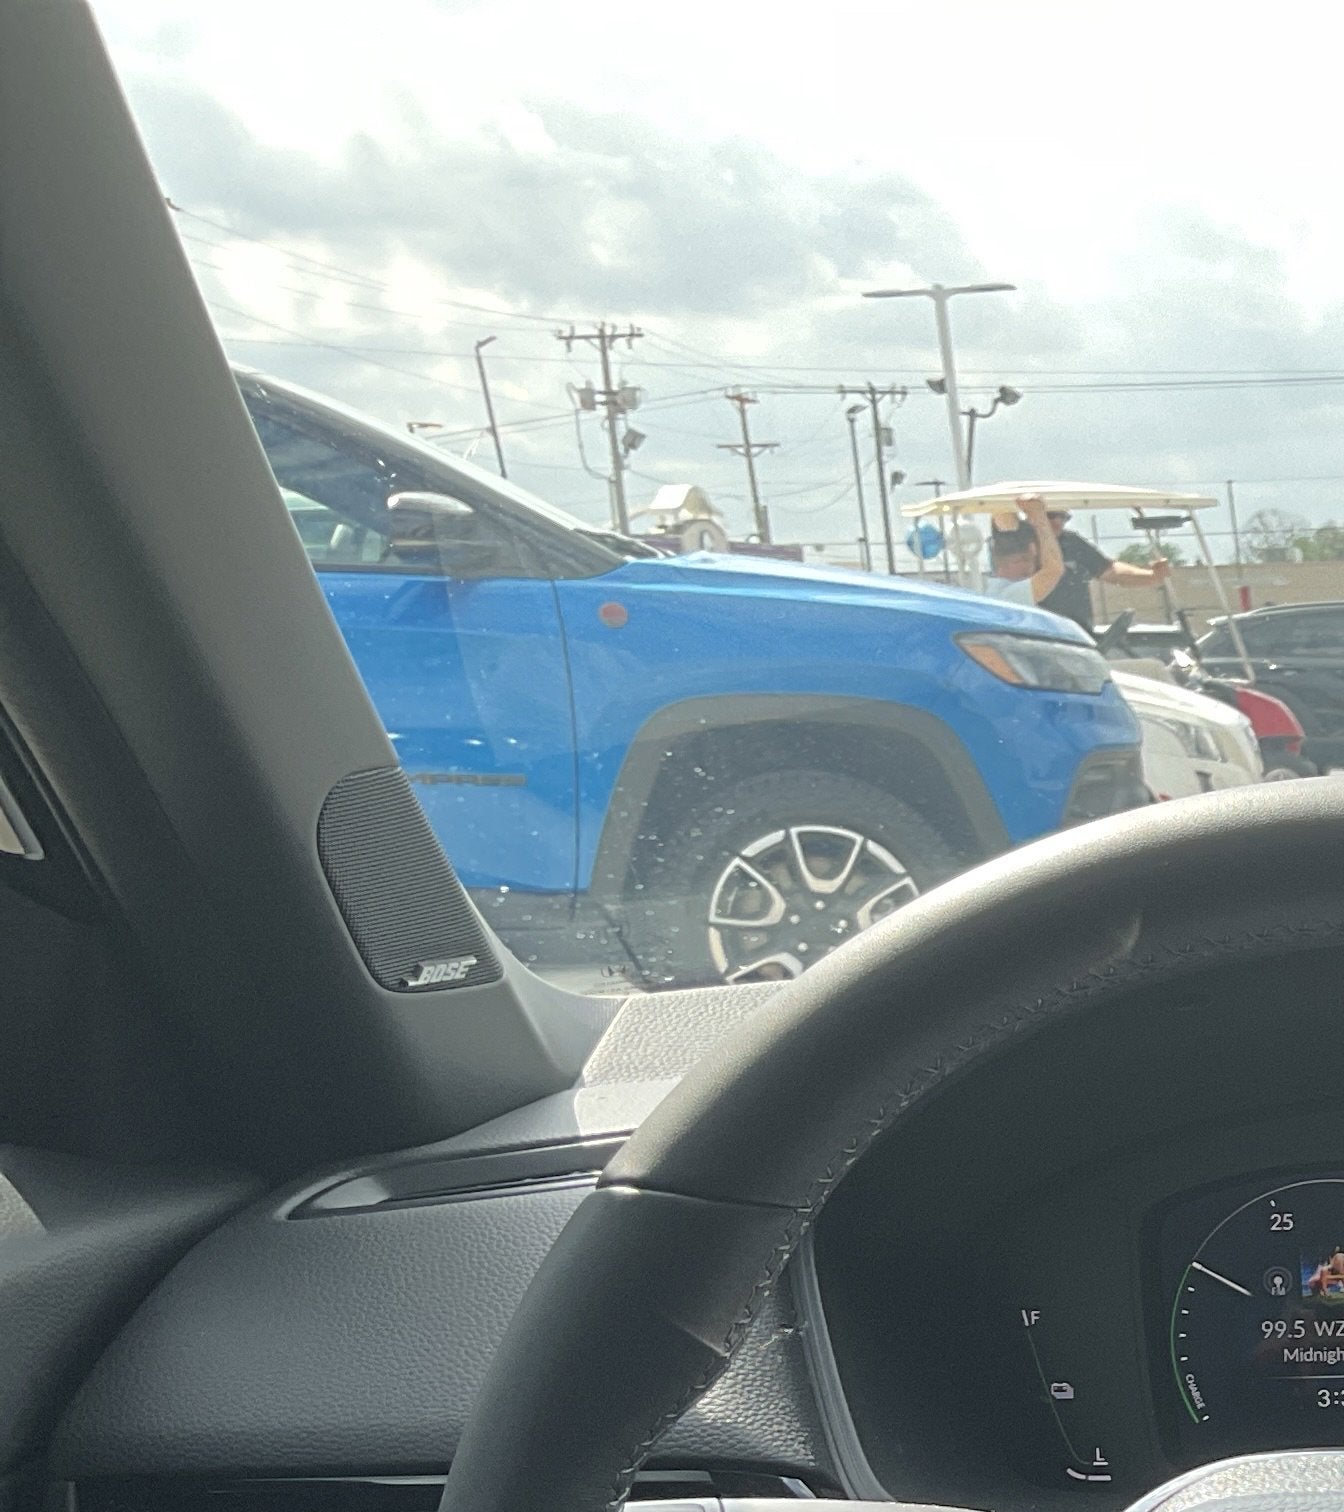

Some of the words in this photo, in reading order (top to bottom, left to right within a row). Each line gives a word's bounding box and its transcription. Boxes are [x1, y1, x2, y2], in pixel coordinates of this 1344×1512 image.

[411, 959, 474, 985] BOSE
[1270, 1213, 1294, 1231] 25
[1031, 1310, 1040, 1325] F
[1261, 1320, 1306, 1339] 99.5
[1185, 1373, 1206, 1410] CHARGE
[1095, 1447, 1106, 1462] L
